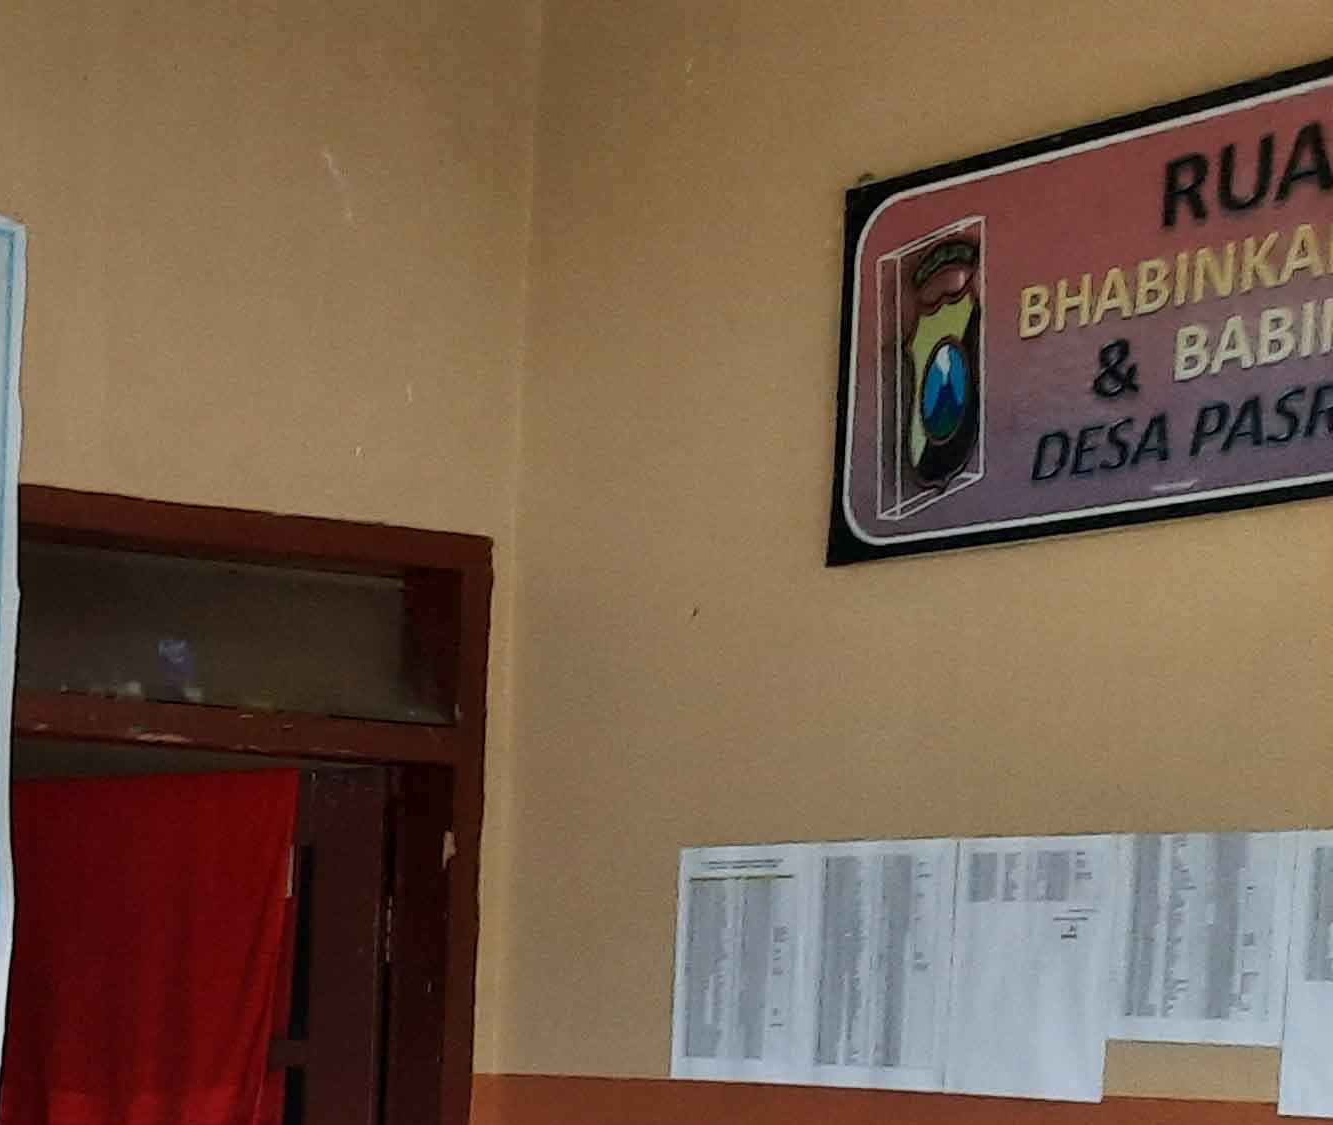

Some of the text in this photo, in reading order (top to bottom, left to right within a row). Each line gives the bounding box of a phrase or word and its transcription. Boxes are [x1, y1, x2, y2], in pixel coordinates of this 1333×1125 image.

[1163, 120, 1333, 230] RUA
[1020, 222, 1333, 339] BHABINKA
[1092, 339, 1141, 398] &
[1032, 412, 1170, 481] DESA
